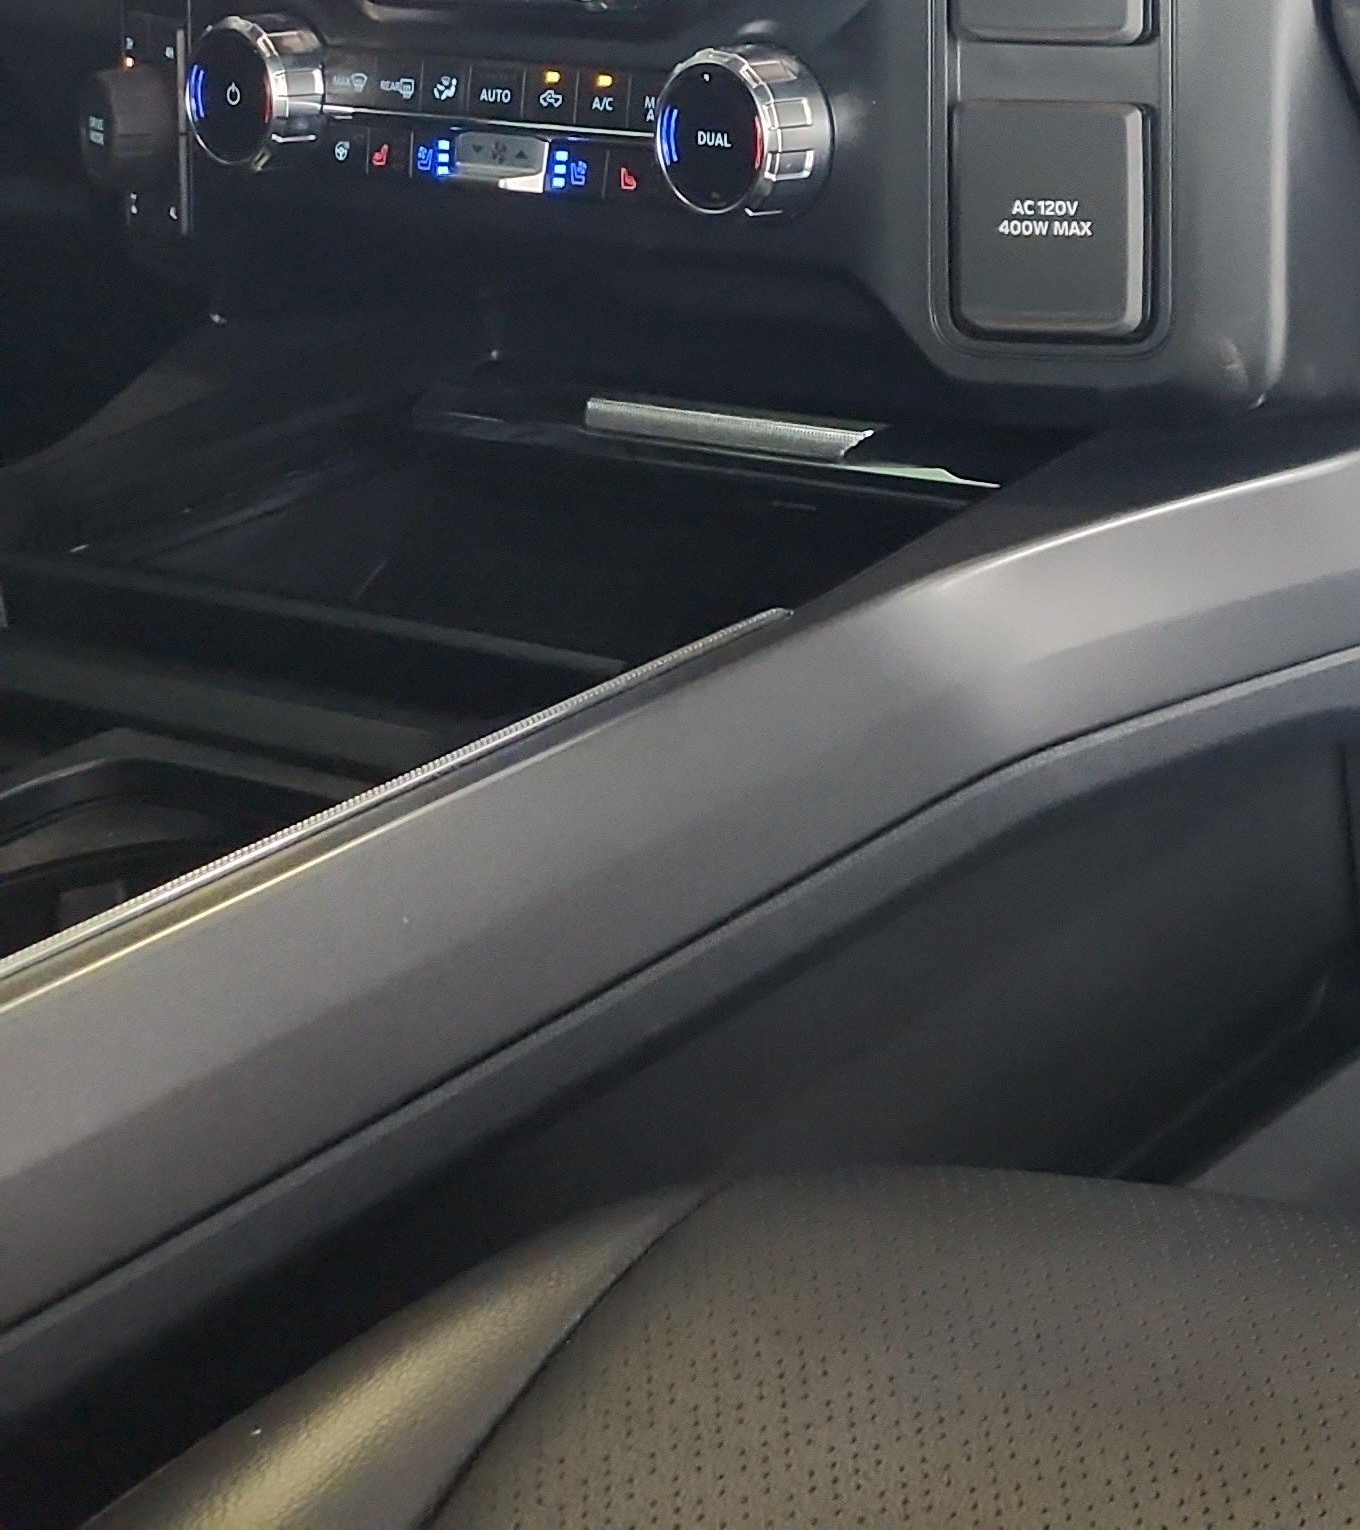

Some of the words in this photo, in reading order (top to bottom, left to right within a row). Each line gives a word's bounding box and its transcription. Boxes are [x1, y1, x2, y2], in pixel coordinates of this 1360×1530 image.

[480, 88, 512, 103] AUTO
[592, 96, 614, 111] A/C
[697, 131, 732, 148] DUAL
[1012, 199, 1035, 215] AC
[1037, 200, 1079, 216] 120V
[998, 219, 1050, 236] 400W
[1052, 220, 1093, 237] MAX
